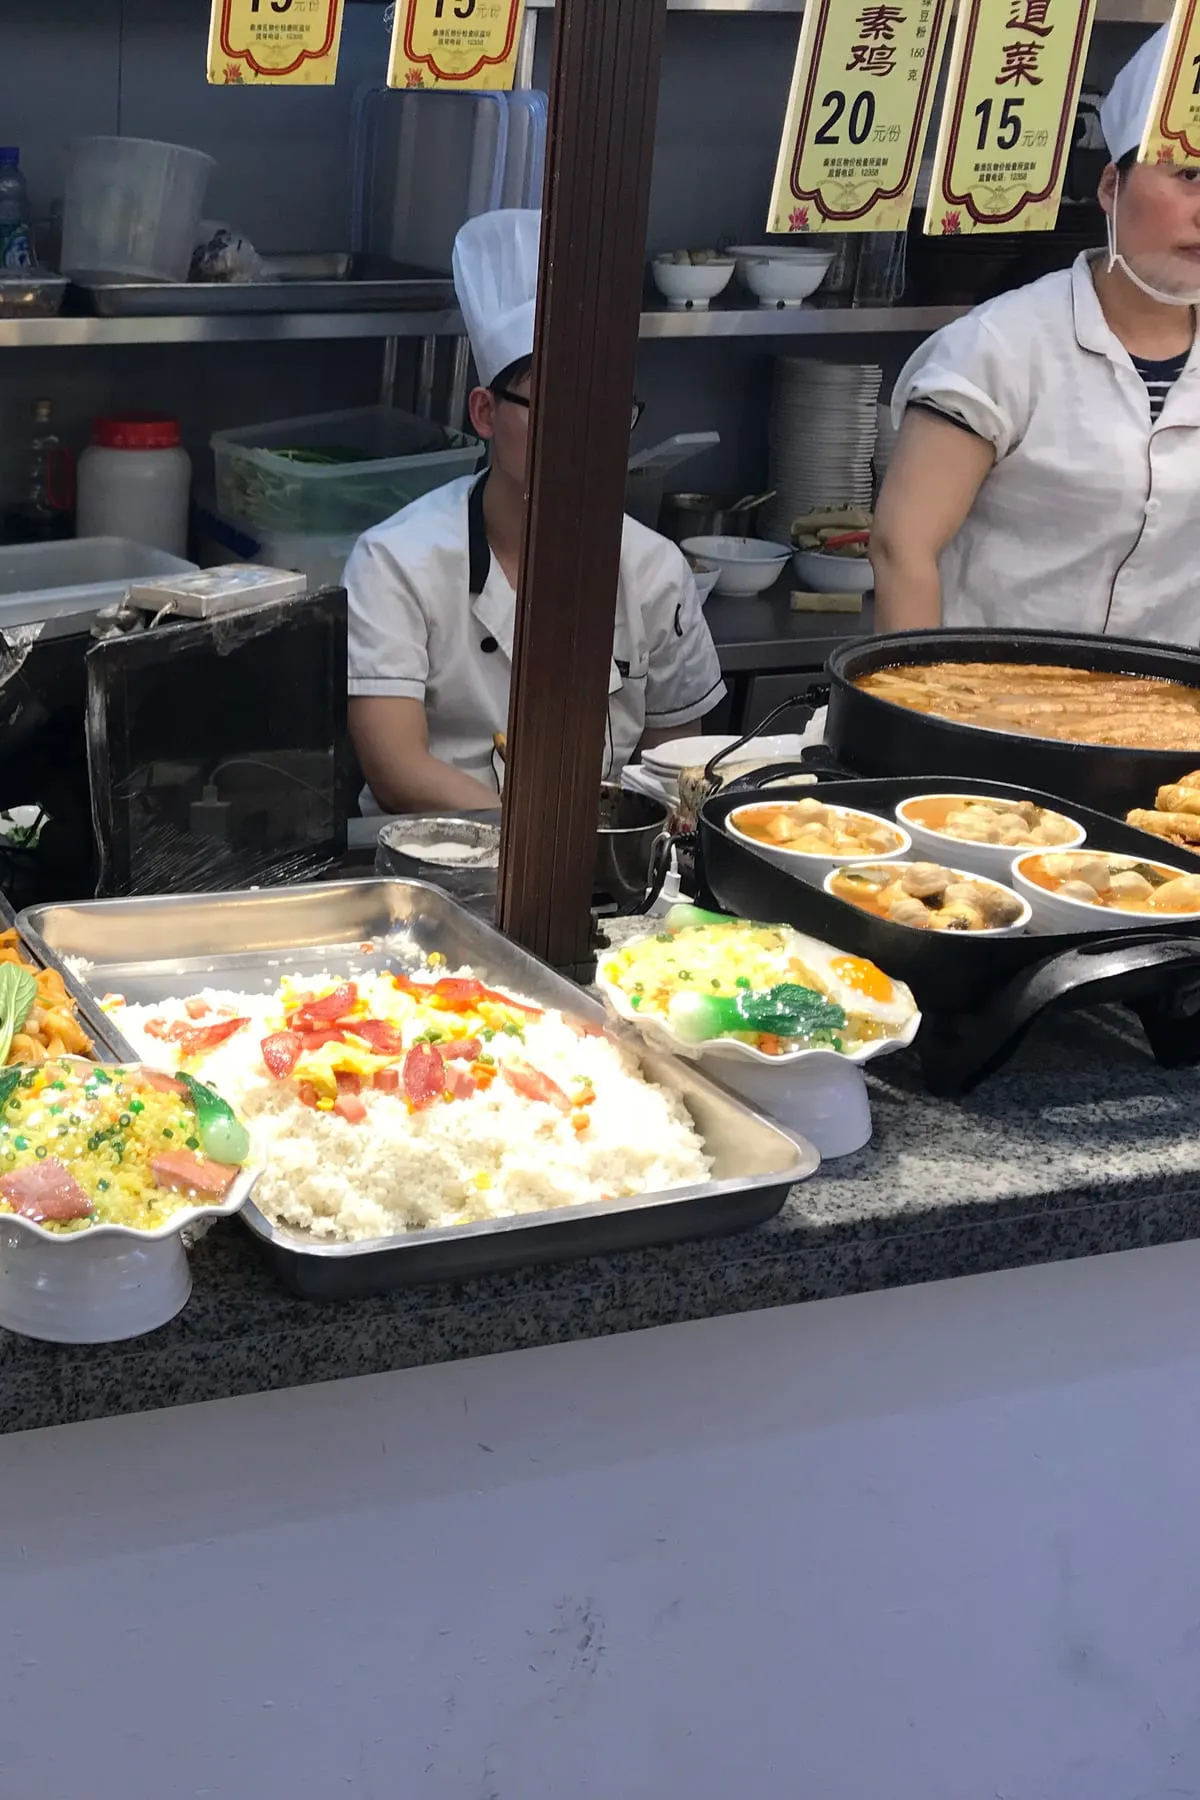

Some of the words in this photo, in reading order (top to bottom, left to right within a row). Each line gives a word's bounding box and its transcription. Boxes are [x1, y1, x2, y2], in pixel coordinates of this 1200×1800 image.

[846, 4, 907, 77] 素鸡
[995, 0, 1054, 87] 道菜
[814, 90, 875, 145] 20
[974, 97, 1025, 150] 15
